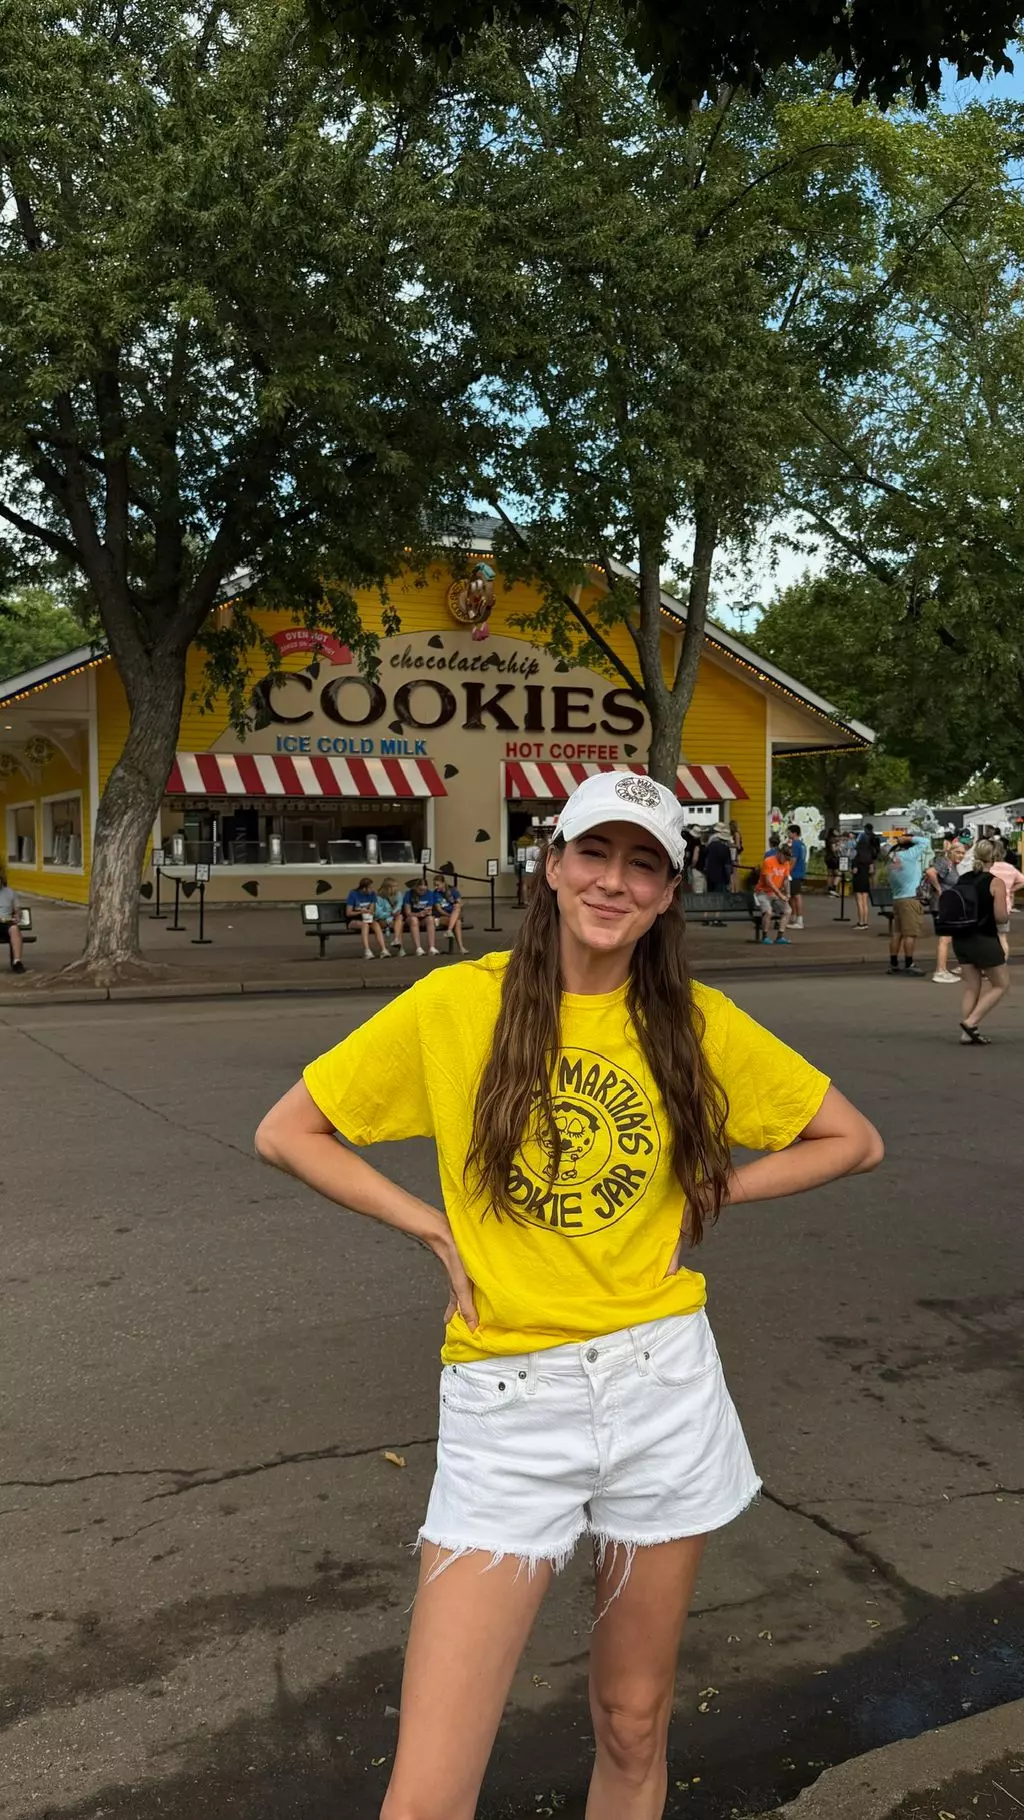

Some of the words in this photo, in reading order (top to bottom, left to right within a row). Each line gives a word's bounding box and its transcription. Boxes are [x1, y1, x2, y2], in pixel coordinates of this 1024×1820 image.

[390, 644, 490, 672] chocolate
[496, 651, 540, 680] chip
[254, 671, 645, 736] COOKIES
[276, 735, 312, 753] ICE
[317, 736, 375, 755] COLD
[380, 738, 428, 756] MILK
[506, 742, 545, 759] HOT
[549, 743, 619, 760] COFFEE
[558, 1056, 654, 1156] MARTHA'S
[591, 1164, 647, 1220] JAR
